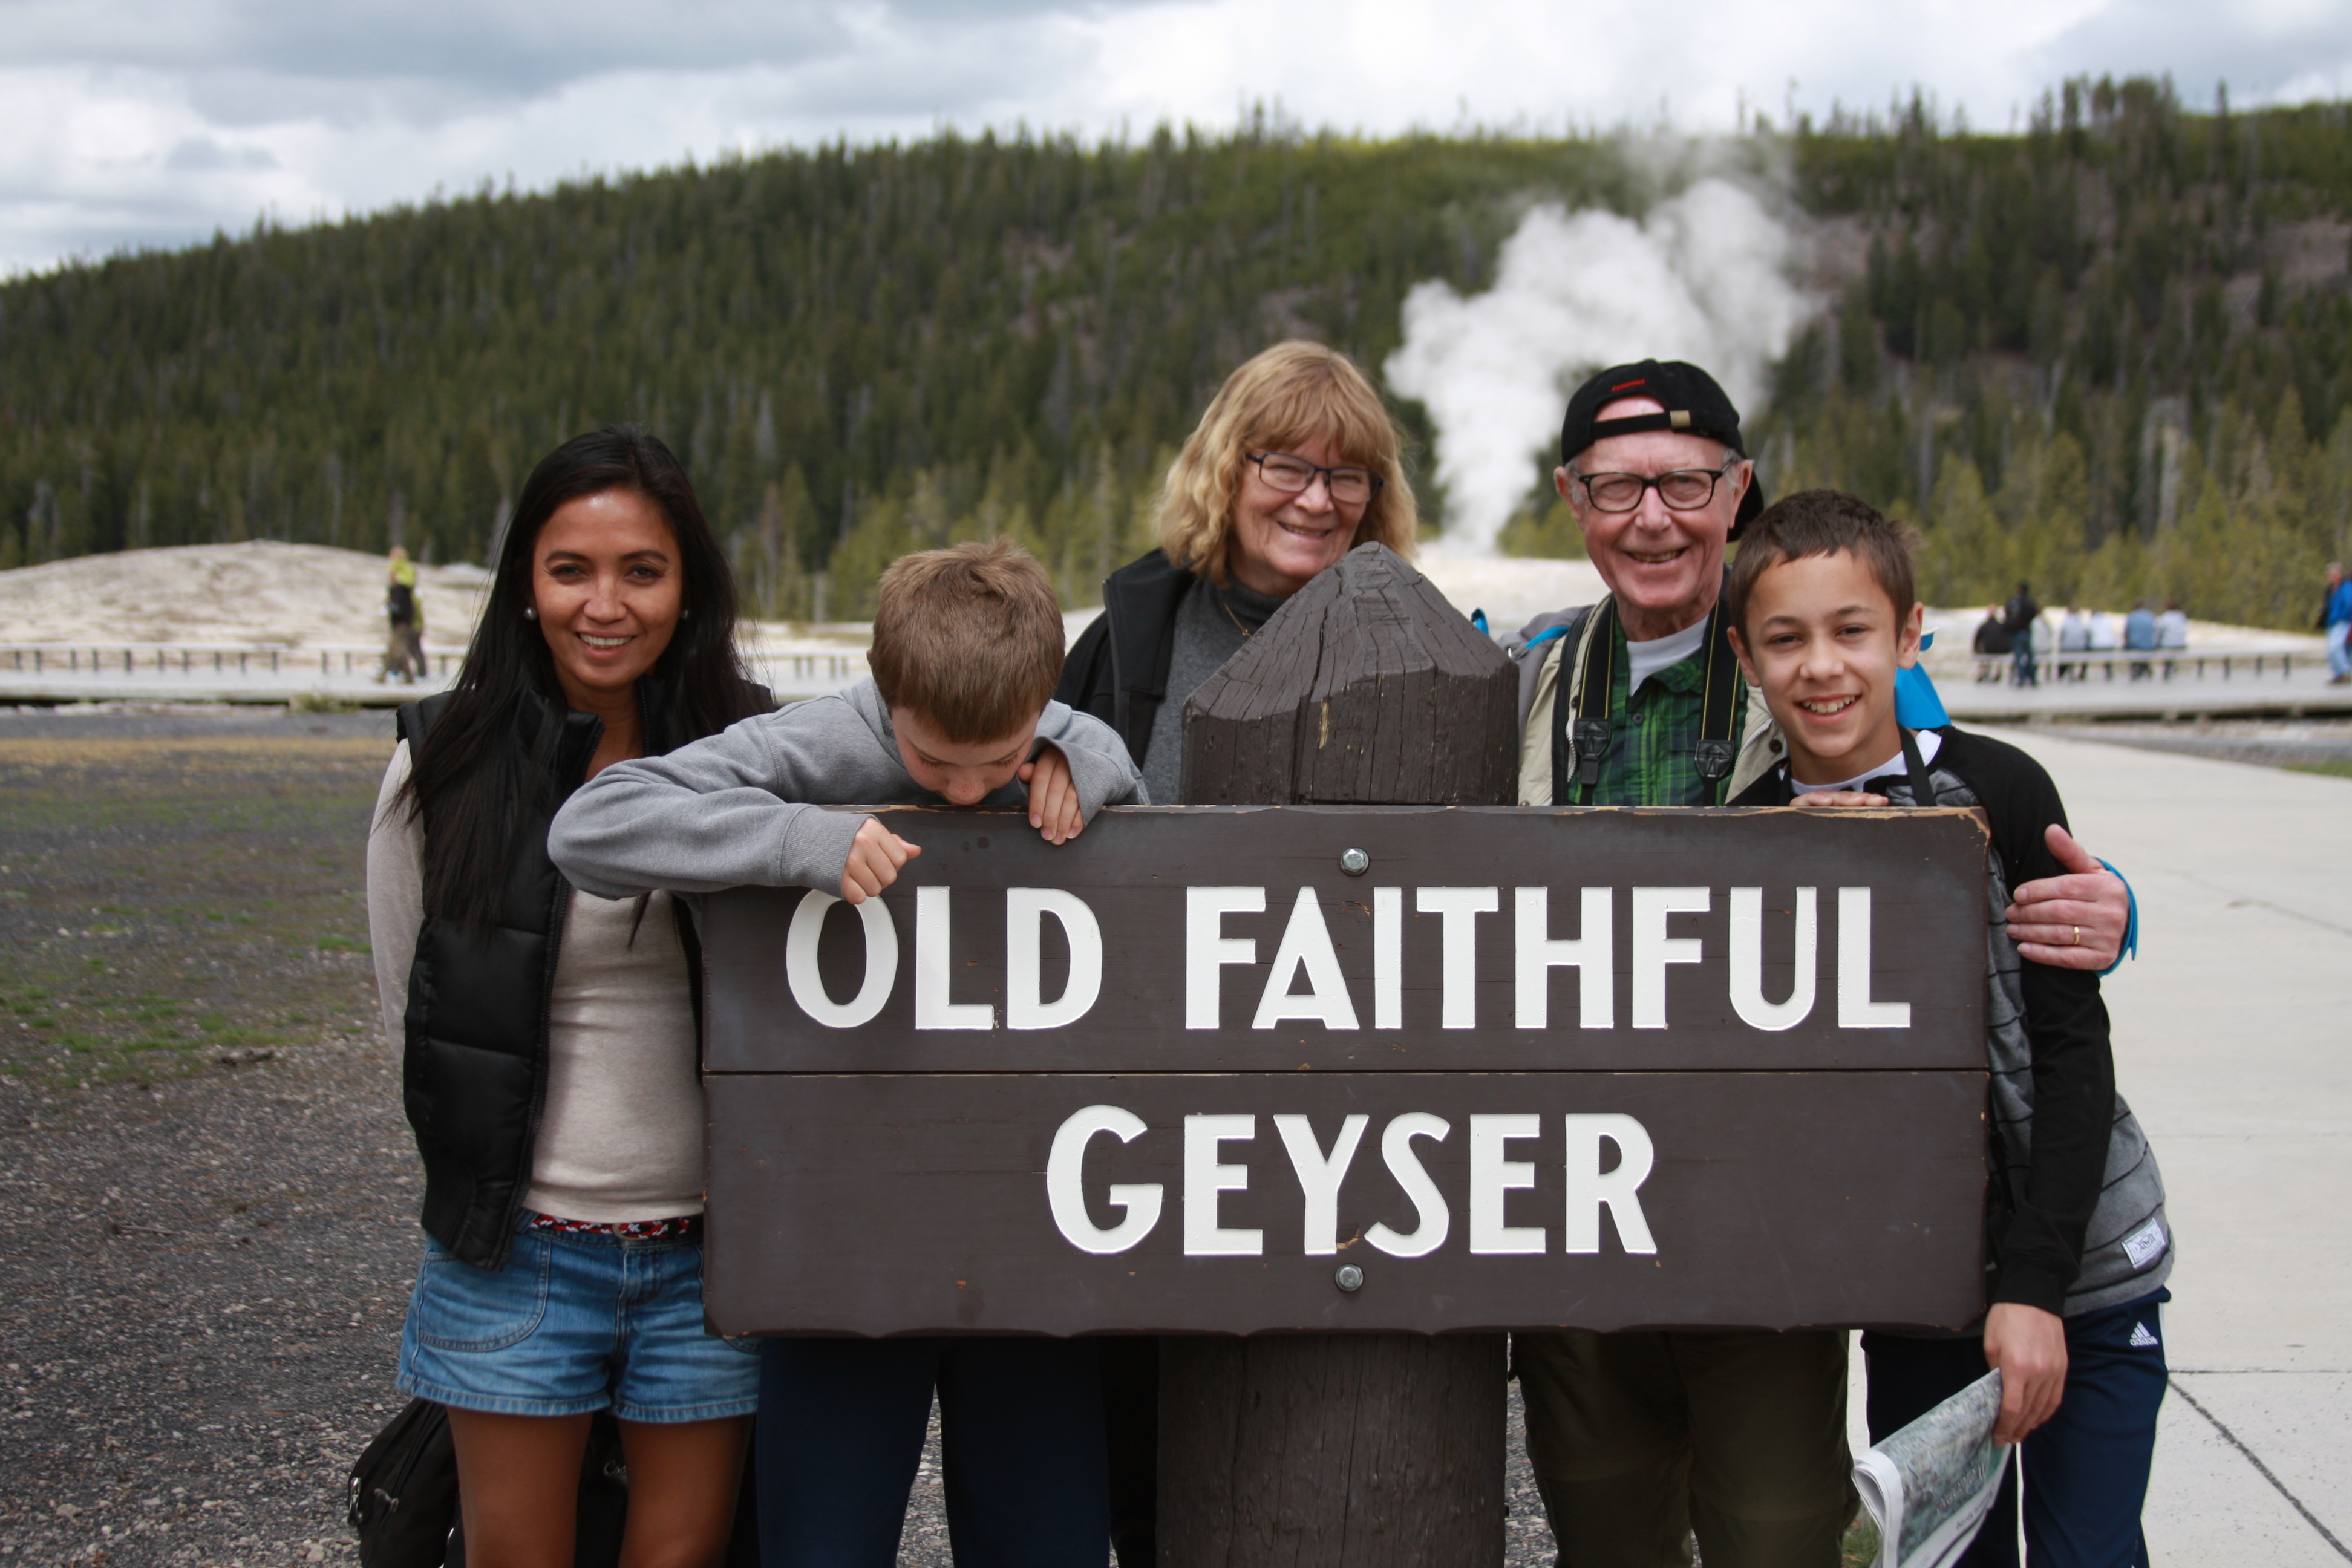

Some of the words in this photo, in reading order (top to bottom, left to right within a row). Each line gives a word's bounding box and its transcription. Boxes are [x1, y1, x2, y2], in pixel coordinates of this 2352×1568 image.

[786, 886, 1103, 1030] OLD
[1185, 886, 1911, 1031] FAITHFUL
[1046, 1105, 1658, 1258] GEYSER
[2129, 1336, 2158, 1347] adidas
